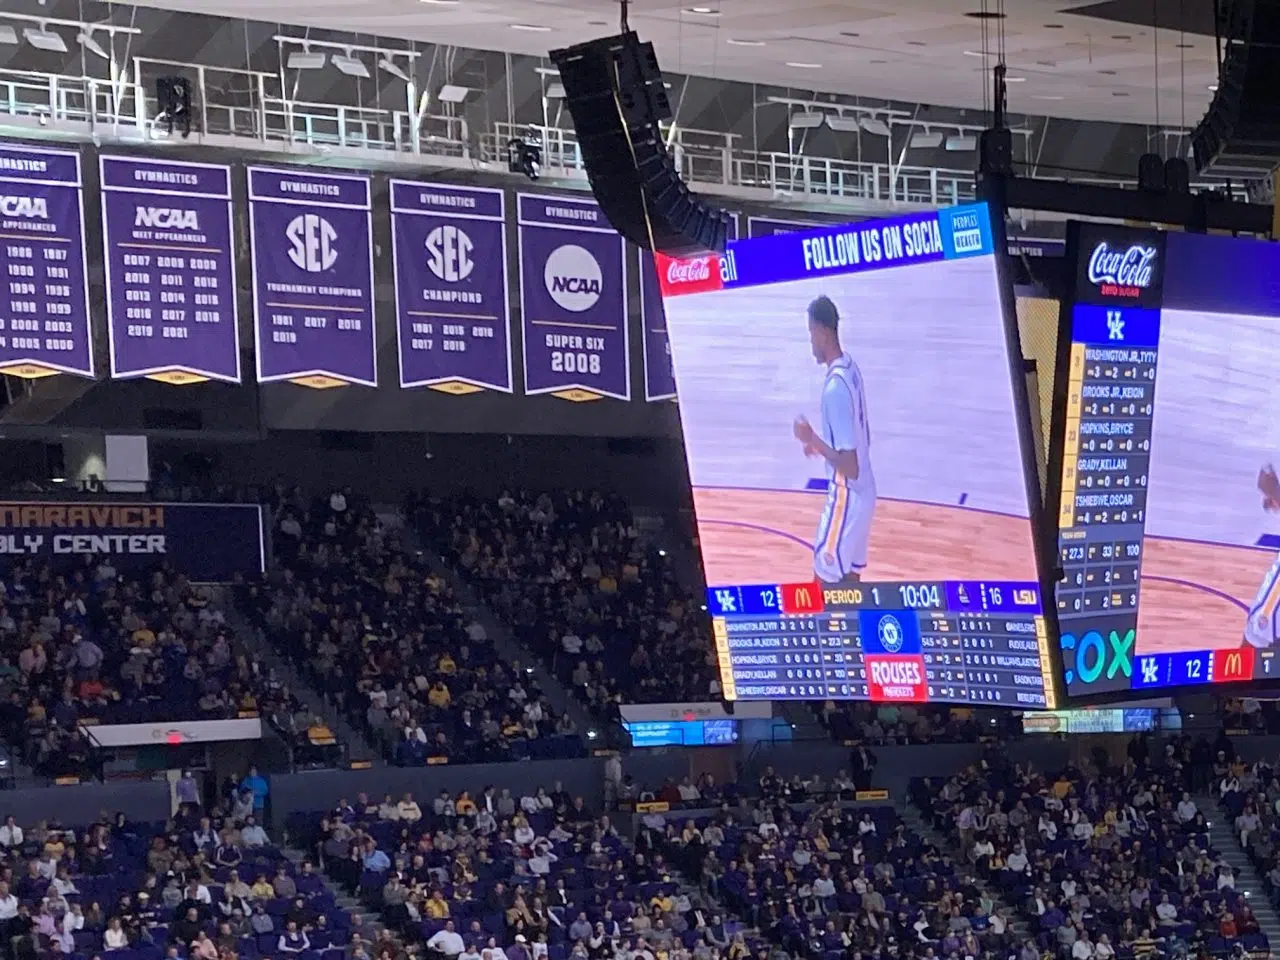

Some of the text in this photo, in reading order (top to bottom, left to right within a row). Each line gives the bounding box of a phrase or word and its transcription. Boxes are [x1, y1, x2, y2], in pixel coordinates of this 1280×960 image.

[135, 170, 198, 185] GYMNASTICS
[280, 180, 340, 196] GYMNASTICS
[420, 193, 476, 208] GYMNASTICS
[135, 206, 200, 230] NCAA
[545, 206, 598, 221] GYMNASTICS
[285, 213, 338, 272] SEC
[802, 219, 943, 271] FOLLOW US ON SOCIA
[424, 225, 474, 282] SEC
[666, 257, 711, 284] Coca-Cola
[1088, 242, 1157, 288] Coca-Cola
[552, 276, 600, 295] NCAA
[423, 288, 482, 304] CHAMPIONS
[546, 334, 605, 350] SUPER SIX
[551, 351, 601, 374] 2008
[53, 535, 167, 553] CENTER
[760, 591, 775, 608] 12
[824, 584, 1037, 608] PERIOD 1 10:04 16 LSU
[871, 660, 922, 686] ROUSES
[1186, 660, 1201, 679] 12
